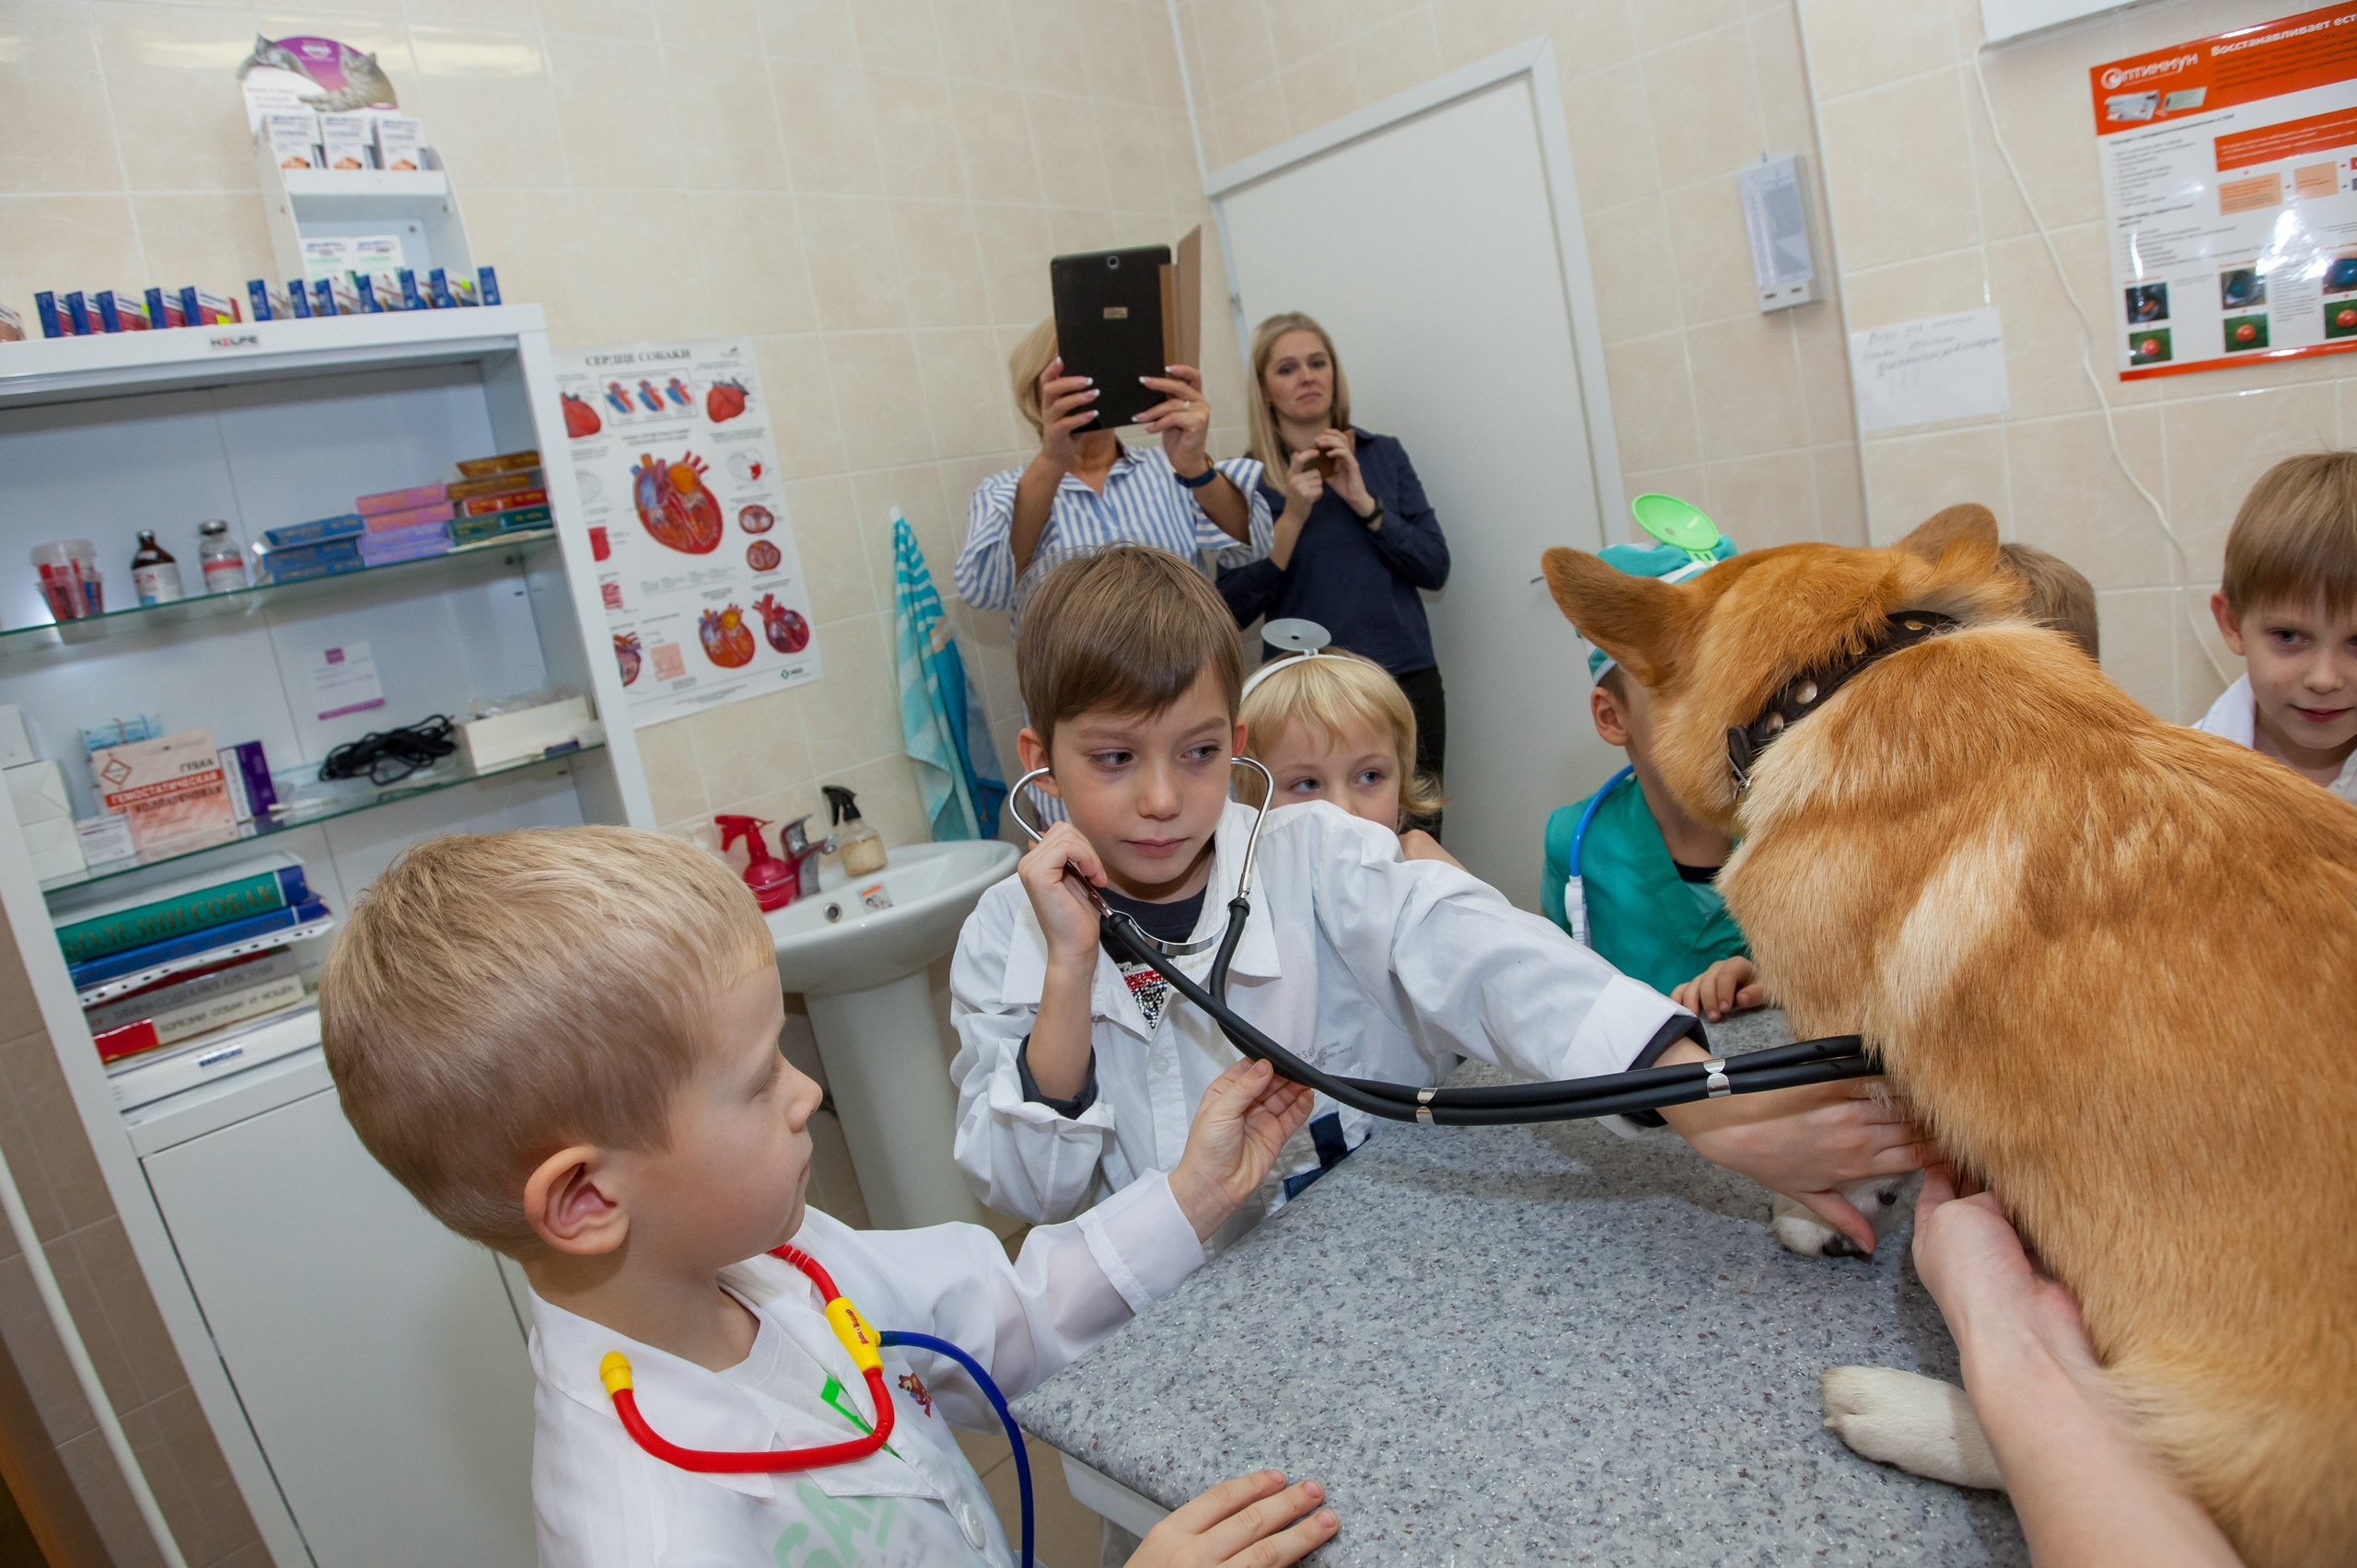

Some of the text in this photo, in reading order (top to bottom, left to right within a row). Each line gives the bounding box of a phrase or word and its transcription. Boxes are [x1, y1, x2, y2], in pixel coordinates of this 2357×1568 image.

[2211, 20, 2331, 57] Восстанавливает
[180, 758, 215, 772] ГУБКА
[191, 883, 276, 922] СОБАК
